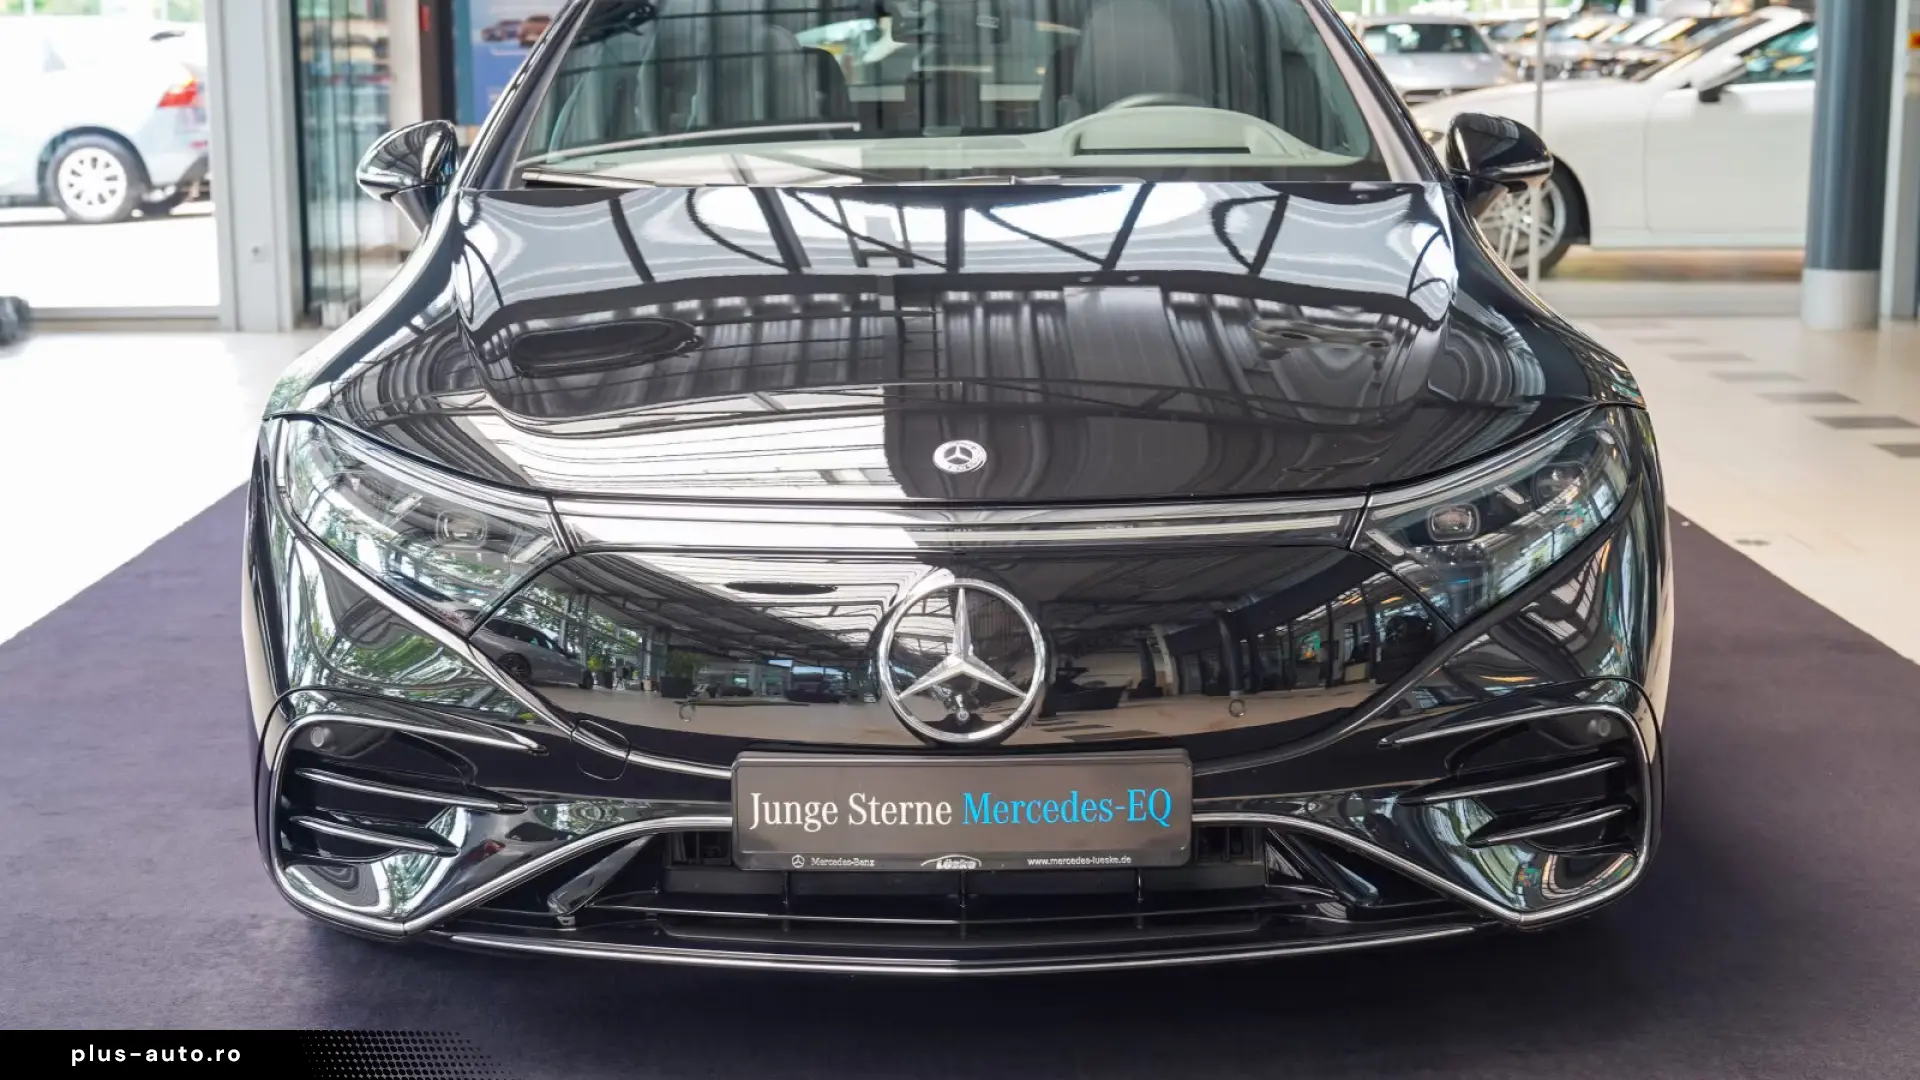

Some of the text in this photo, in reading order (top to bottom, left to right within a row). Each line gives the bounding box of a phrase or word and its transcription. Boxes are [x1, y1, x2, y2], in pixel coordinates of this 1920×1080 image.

[749, 788, 1173, 833] Junge Sterne Mercedes-EQ
[811, 857, 875, 867] Mercedes-Benz
[1027, 855, 1132, 866] www.mercedes-lueske.de
